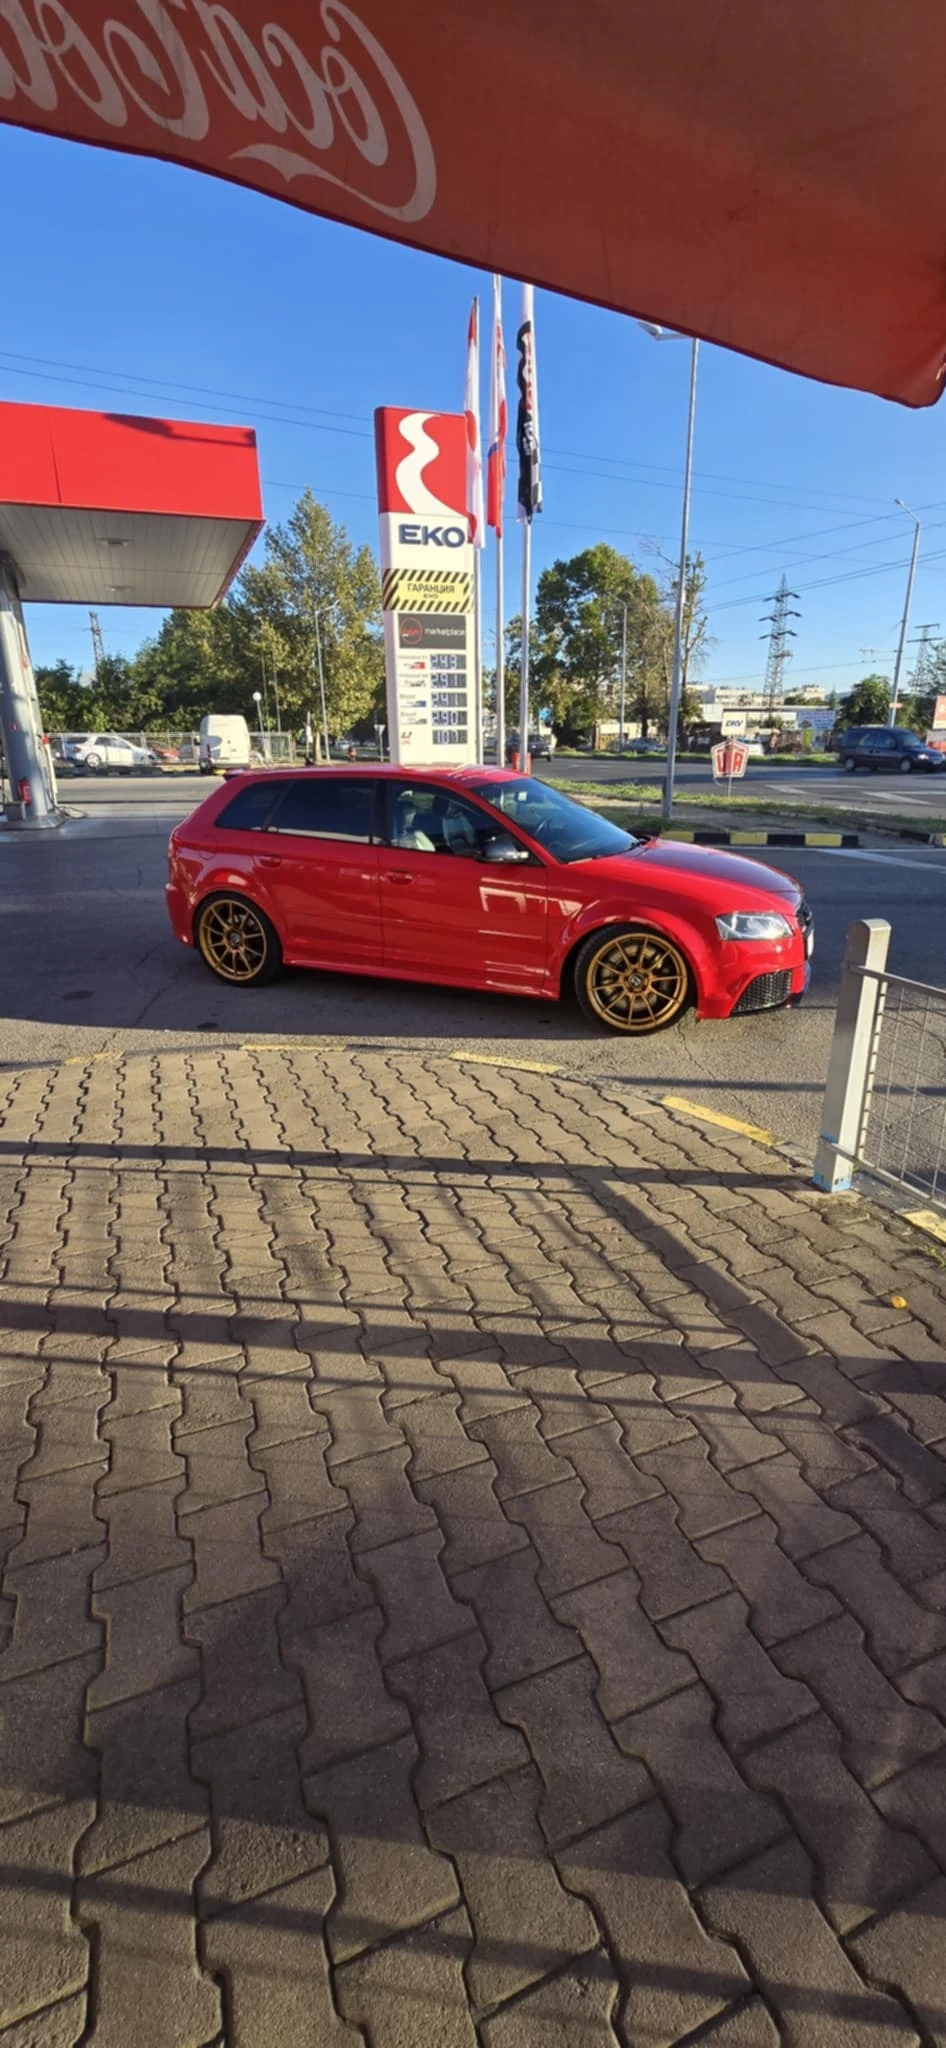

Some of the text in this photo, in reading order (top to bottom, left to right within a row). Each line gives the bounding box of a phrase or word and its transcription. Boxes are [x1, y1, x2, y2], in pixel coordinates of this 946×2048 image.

[398, 523, 465, 548] EKO
[407, 583, 455, 593] ГАРАНЦИЯ
[424, 627, 465, 636] marketplace
